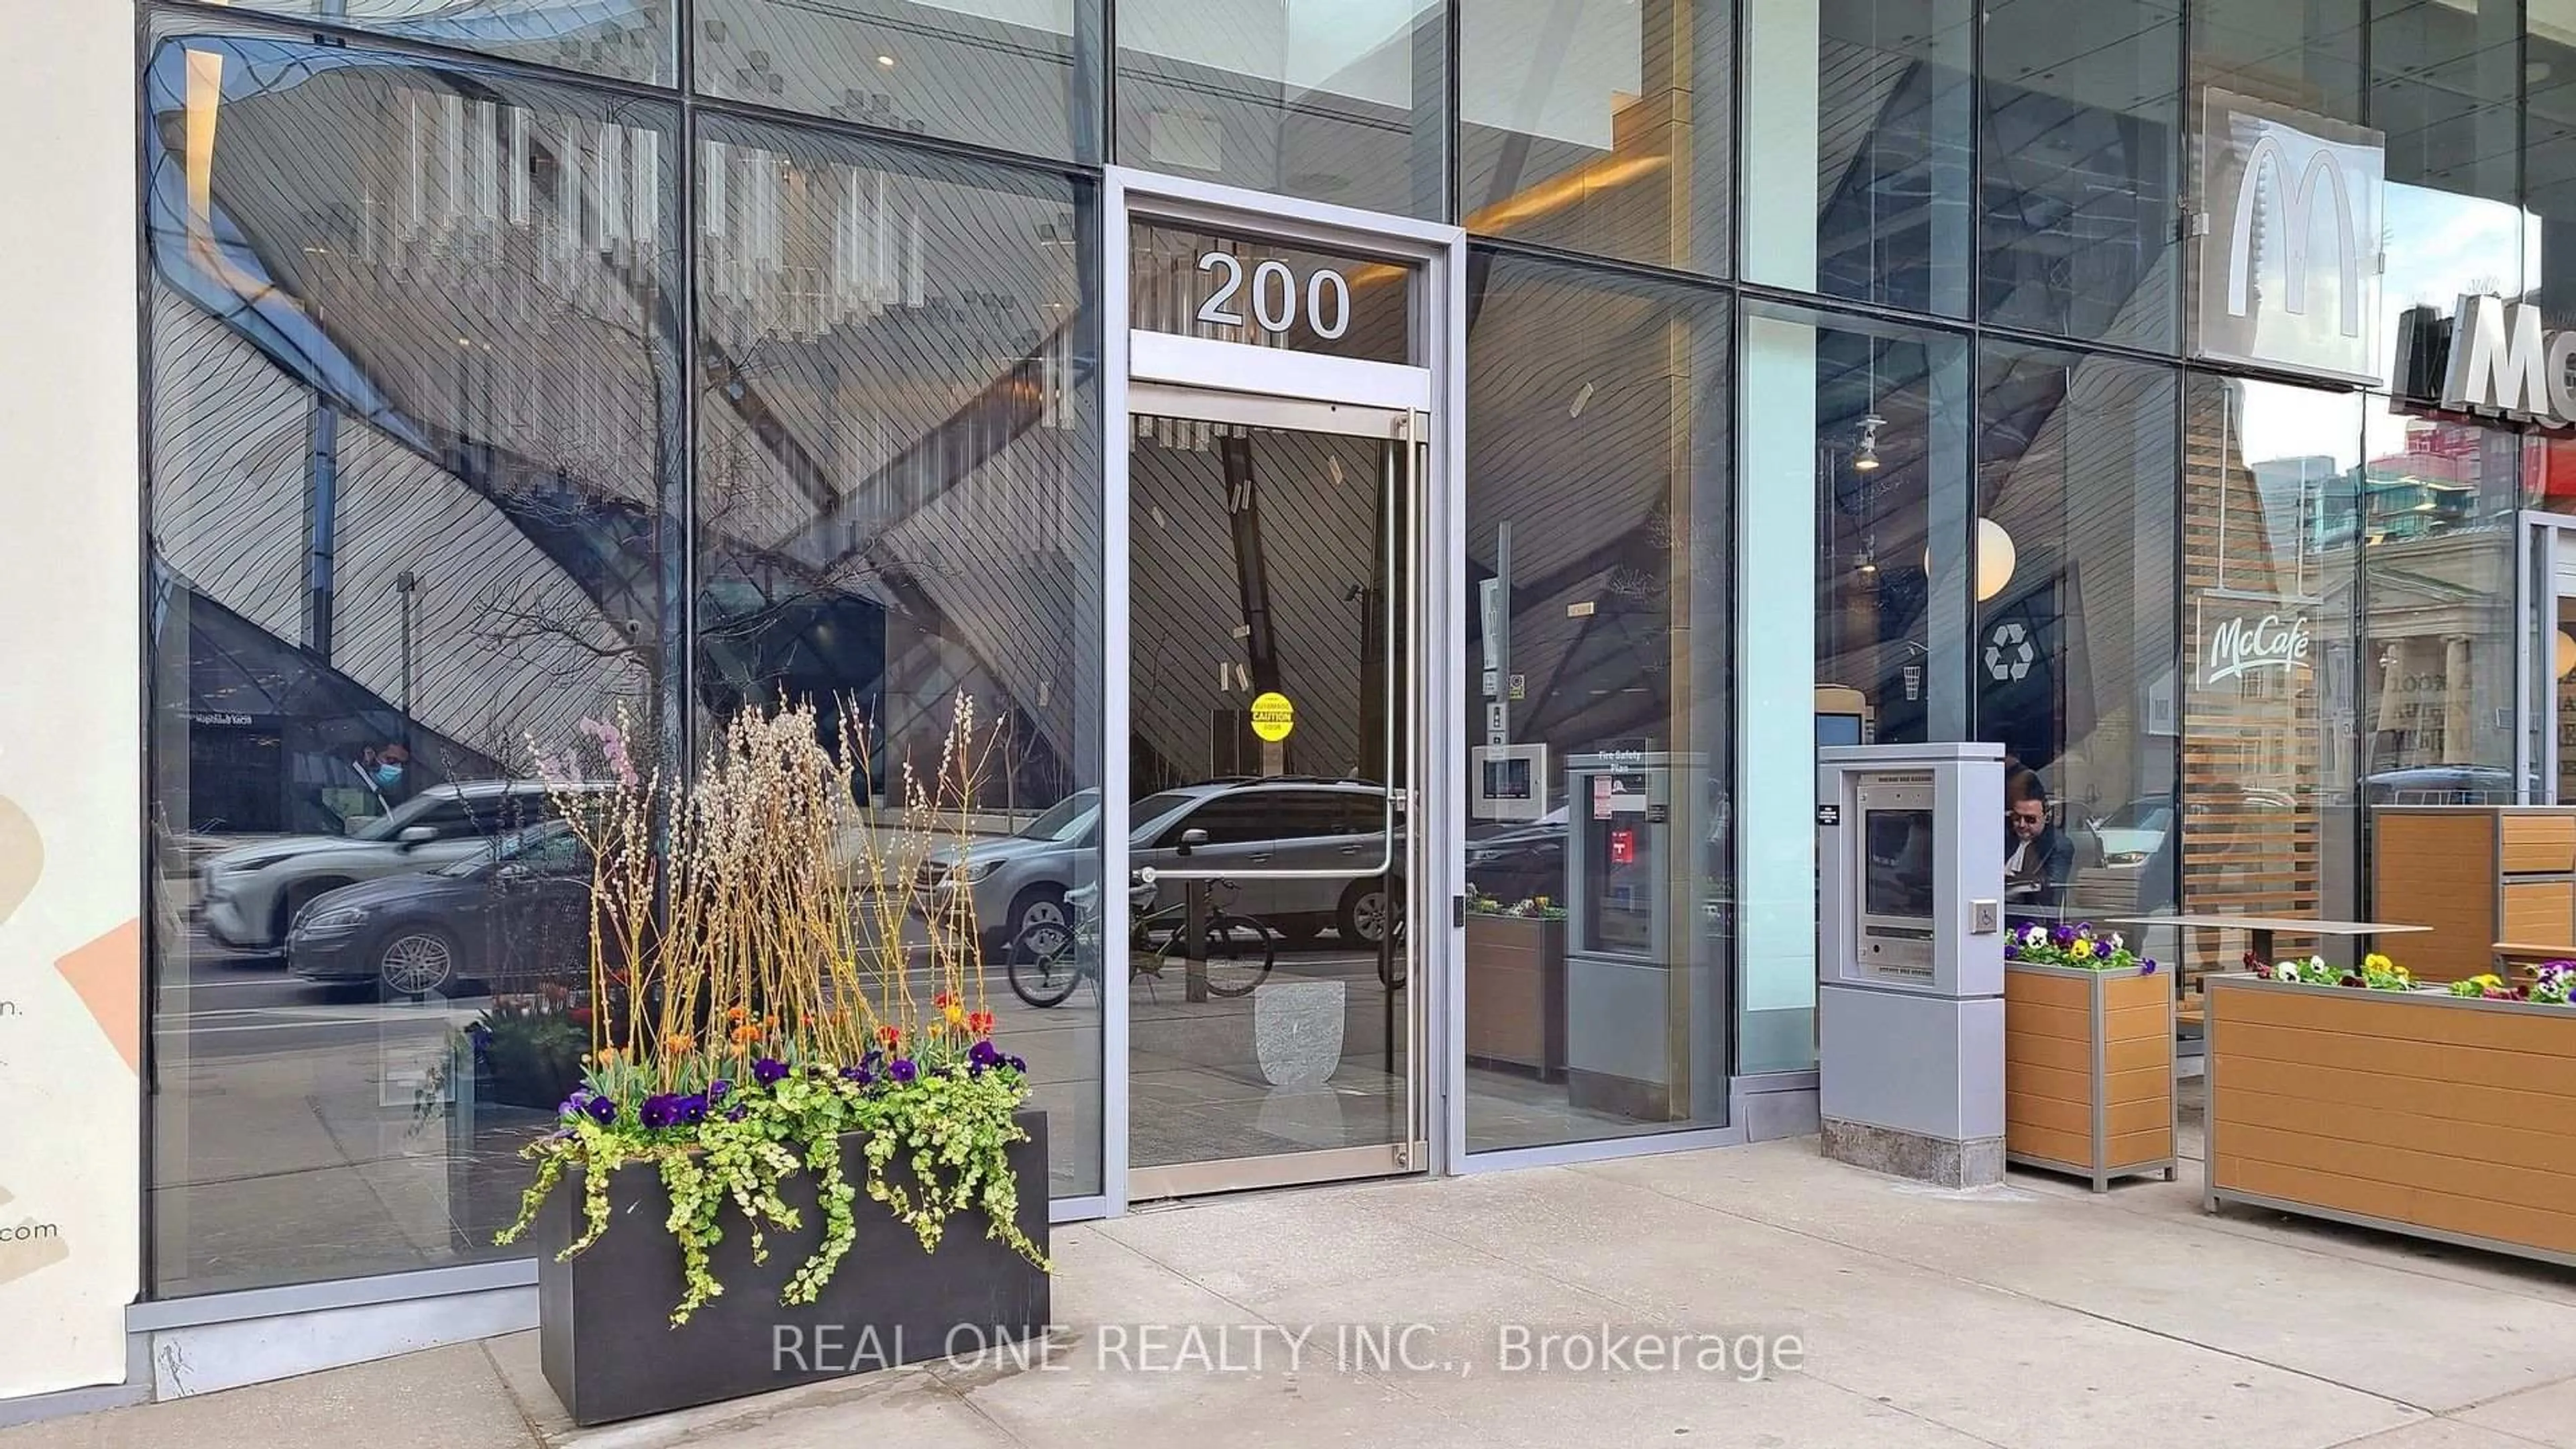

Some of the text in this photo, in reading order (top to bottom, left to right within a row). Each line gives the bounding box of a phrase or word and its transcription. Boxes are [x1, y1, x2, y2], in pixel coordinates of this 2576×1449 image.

[1196, 251, 1351, 340] 200
[2210, 614, 2309, 679] McCafé
[1252, 712, 1291, 720] CAUTION
[1599, 750, 1642, 762] Fire Safety
[1611, 763, 1629, 773] Plan
